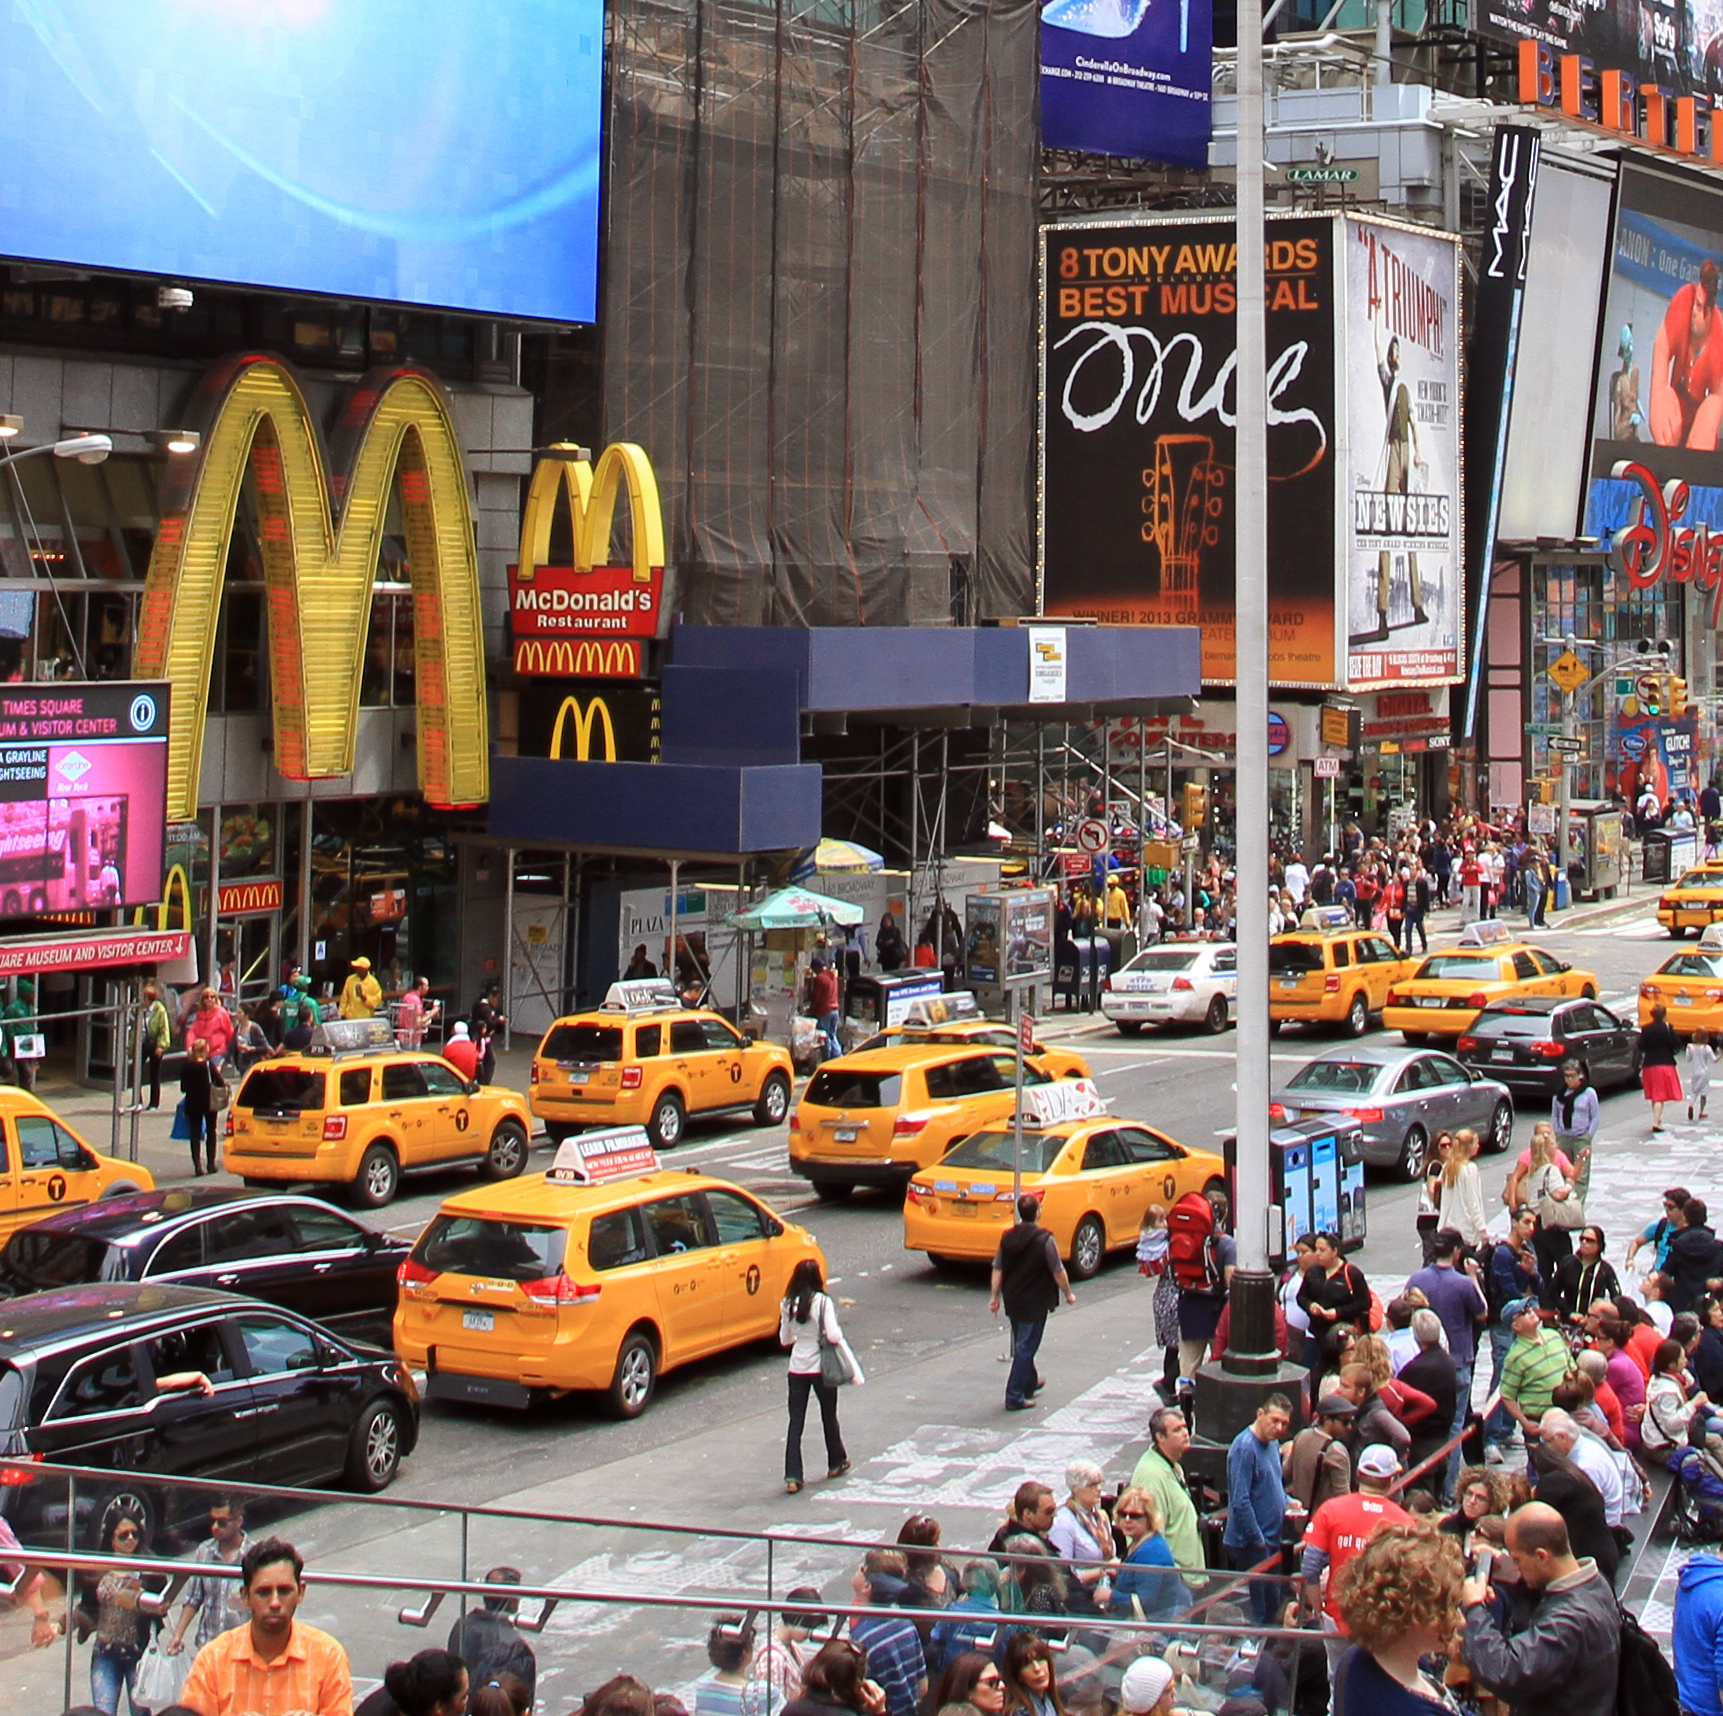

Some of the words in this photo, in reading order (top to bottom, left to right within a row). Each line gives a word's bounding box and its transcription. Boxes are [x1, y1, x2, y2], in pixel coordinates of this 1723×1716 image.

[1654, 12, 1676, 49] Syfy
[1076, 56, 1171, 81] CinderellaOnBroadway.com
[1291, 168, 1355, 182] LAMAR
[1060, 247, 1079, 278] 8
[1083, 246, 1171, 277] TONY
[1658, 247, 1682, 279] One
[1060, 286, 1150, 317] BEST
[1356, 492, 1449, 534] NEWSIES
[515, 588, 653, 612] McDonald's
[537, 614, 627, 630] Restaurant
[1288, 652, 1321, 662] theatre
[2, 700, 37, 716] TIMES
[39, 699, 83, 715] SQUARE
[1428, 735, 1451, 749] SONY
[1665, 734, 1690, 753] GLITCH!
[1317, 757, 1339, 774] ATM
[630, 914, 665, 936] PLAZA
[579, 1141, 606, 1157] LEARN
[605, 1133, 650, 1152] FILMMAKING
[1338, 1535, 1353, 1549] got
